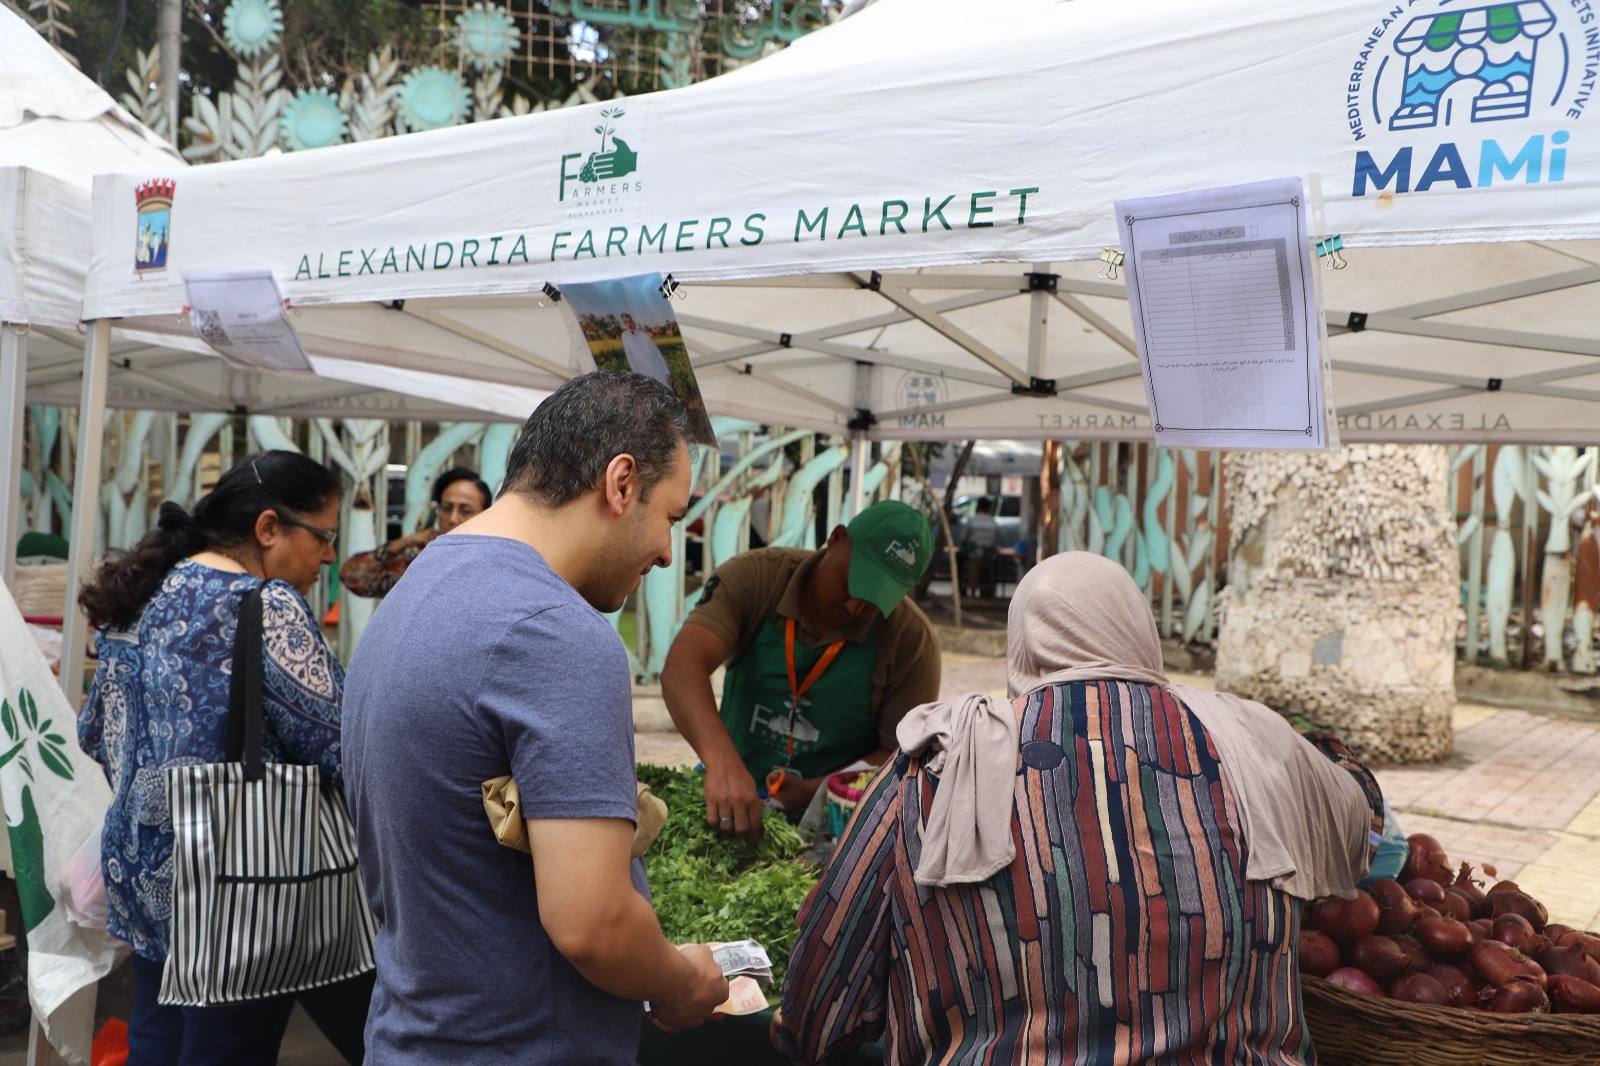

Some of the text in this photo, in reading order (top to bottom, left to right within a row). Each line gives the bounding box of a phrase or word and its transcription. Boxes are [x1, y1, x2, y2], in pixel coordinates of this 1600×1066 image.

[1347, 5, 1404, 141] MEDITERRANEAN
[1566, 27, 1600, 120] INITIATIVE
[577, 197, 619, 208] MARKET
[1352, 130, 1570, 197] MAMi
[295, 187, 1040, 280] ALEXANDRIA FARMERS MARKET
[568, 207, 624, 218] ALEXANDRIA
